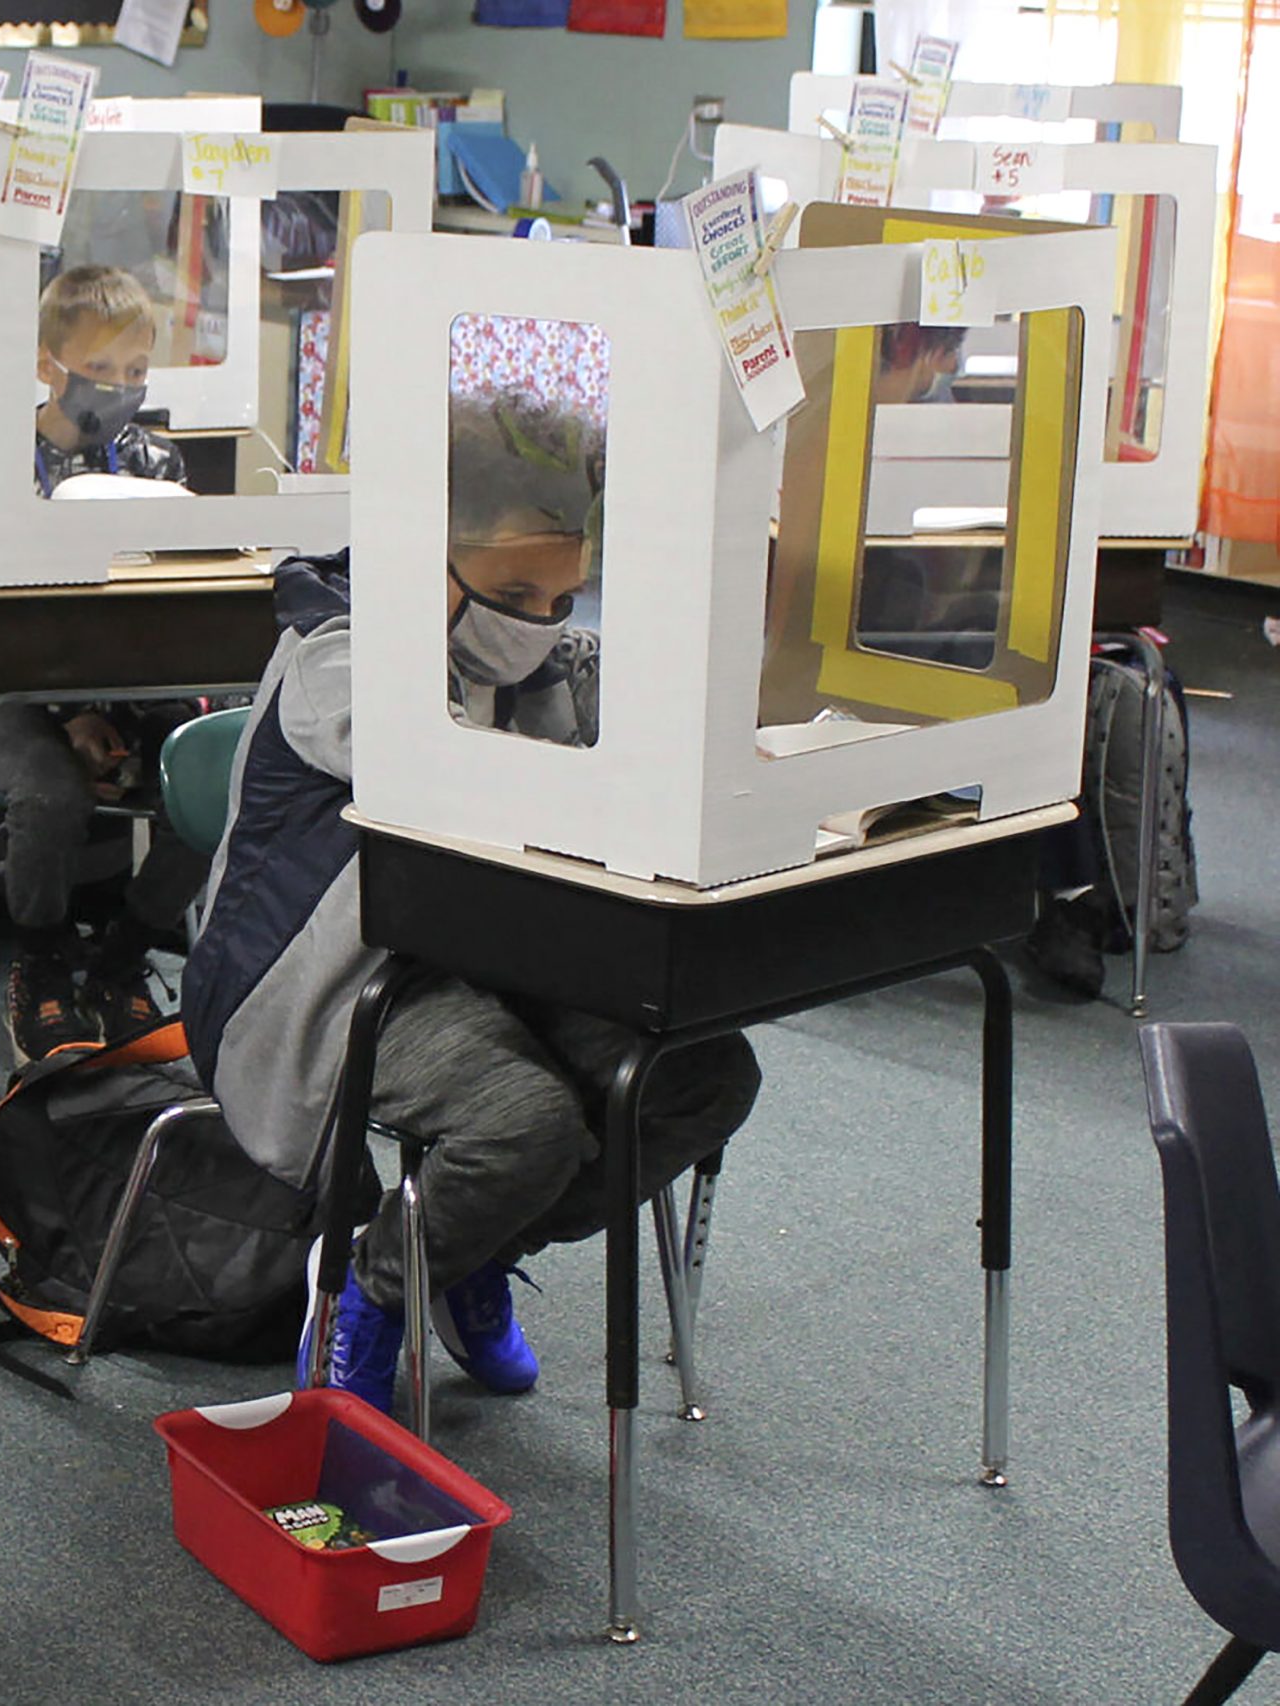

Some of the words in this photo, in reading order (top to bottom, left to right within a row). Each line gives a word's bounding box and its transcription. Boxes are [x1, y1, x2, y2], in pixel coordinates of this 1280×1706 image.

[702, 214, 746, 245] CHOICES
[710, 234, 745, 259] Great
[741, 344, 777, 374] Parent
